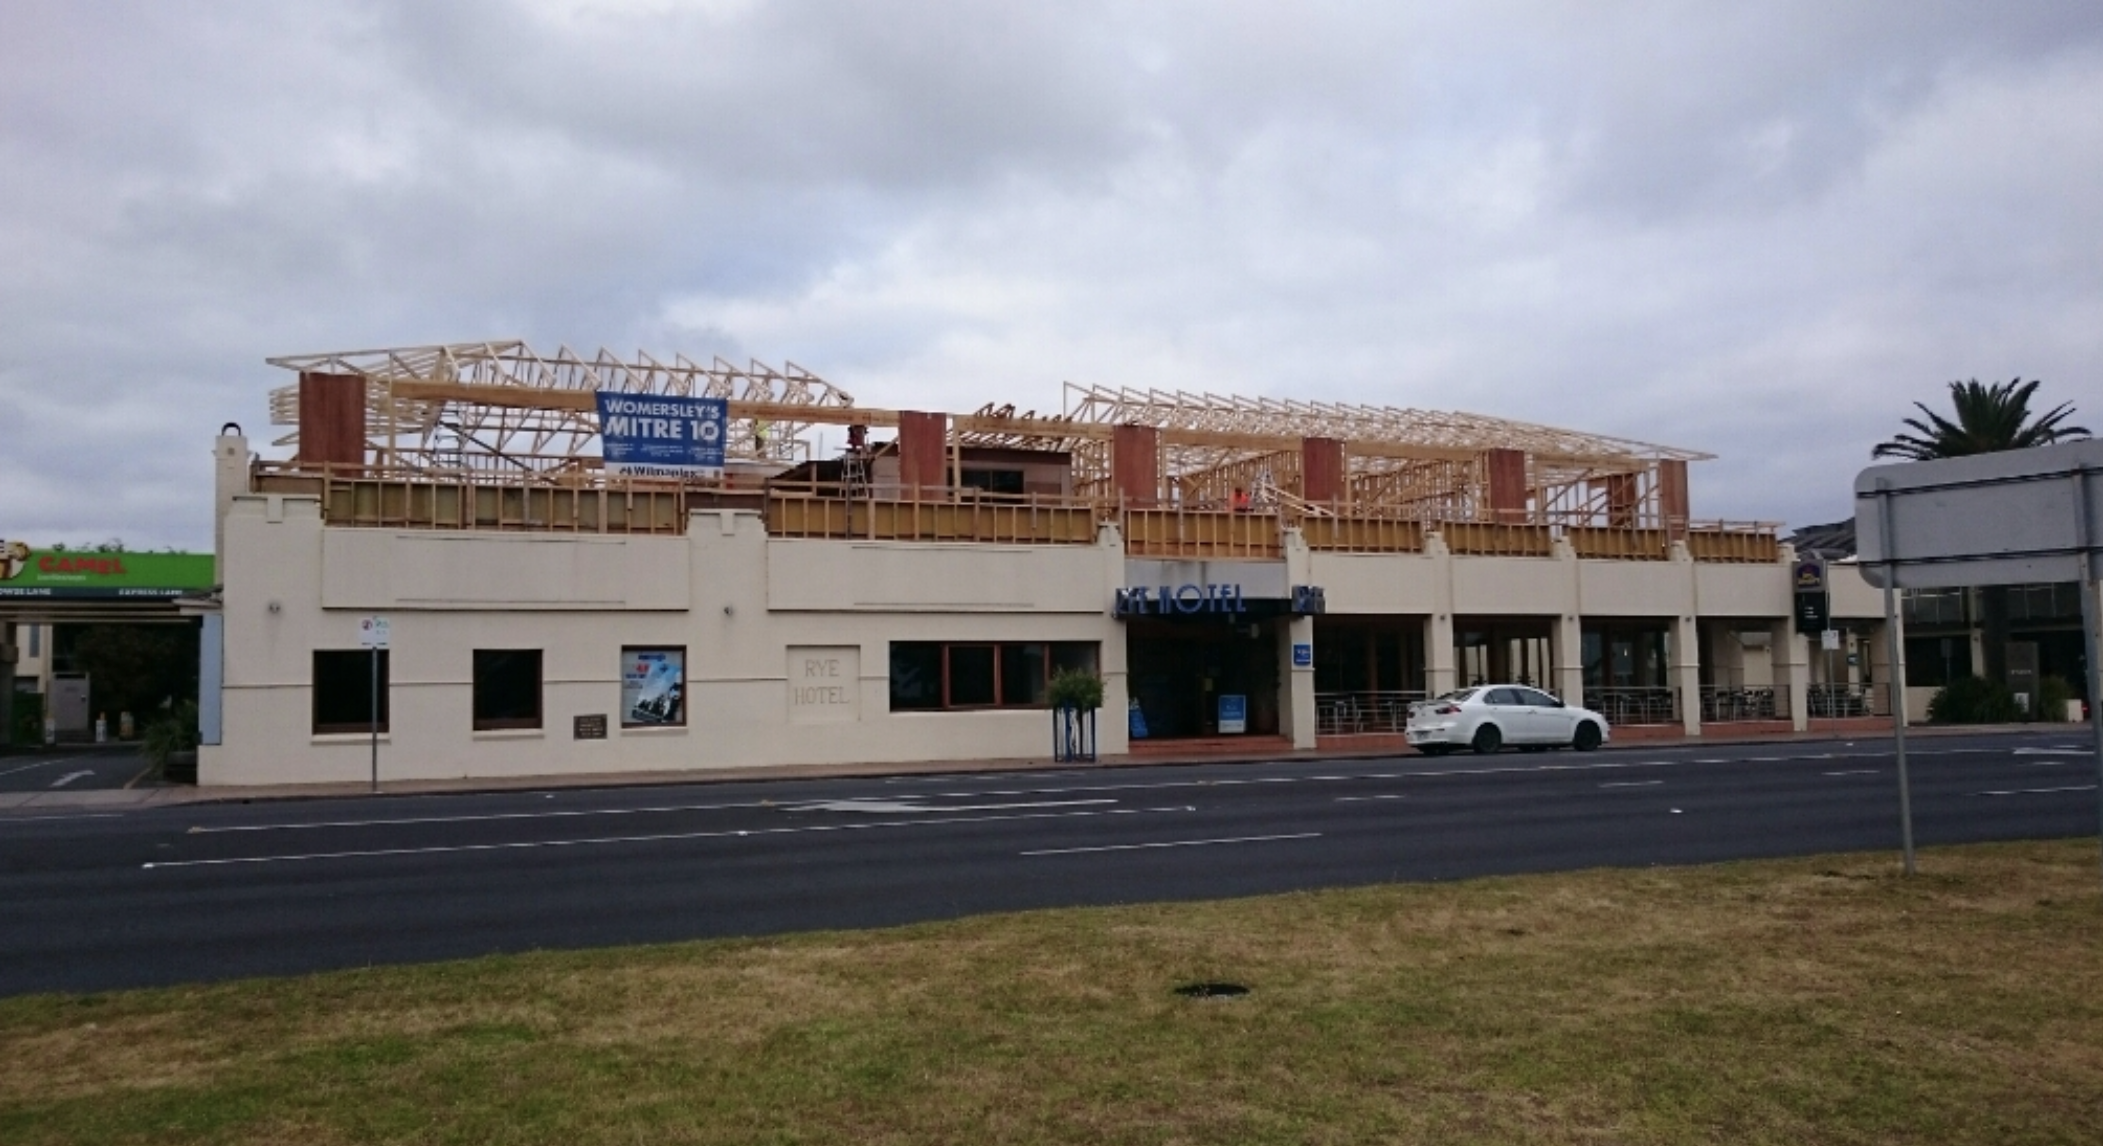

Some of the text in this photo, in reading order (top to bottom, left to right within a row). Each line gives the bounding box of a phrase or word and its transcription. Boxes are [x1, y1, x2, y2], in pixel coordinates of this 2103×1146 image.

[604, 399, 720, 420] WOMERSLEY'S
[604, 416, 720, 441] MITRE 10
[38, 556, 127, 574] CAMEL
[1159, 584, 1246, 614] HOTEL
[805, 659, 840, 677] RYE
[794, 686, 850, 706] HOTEL
